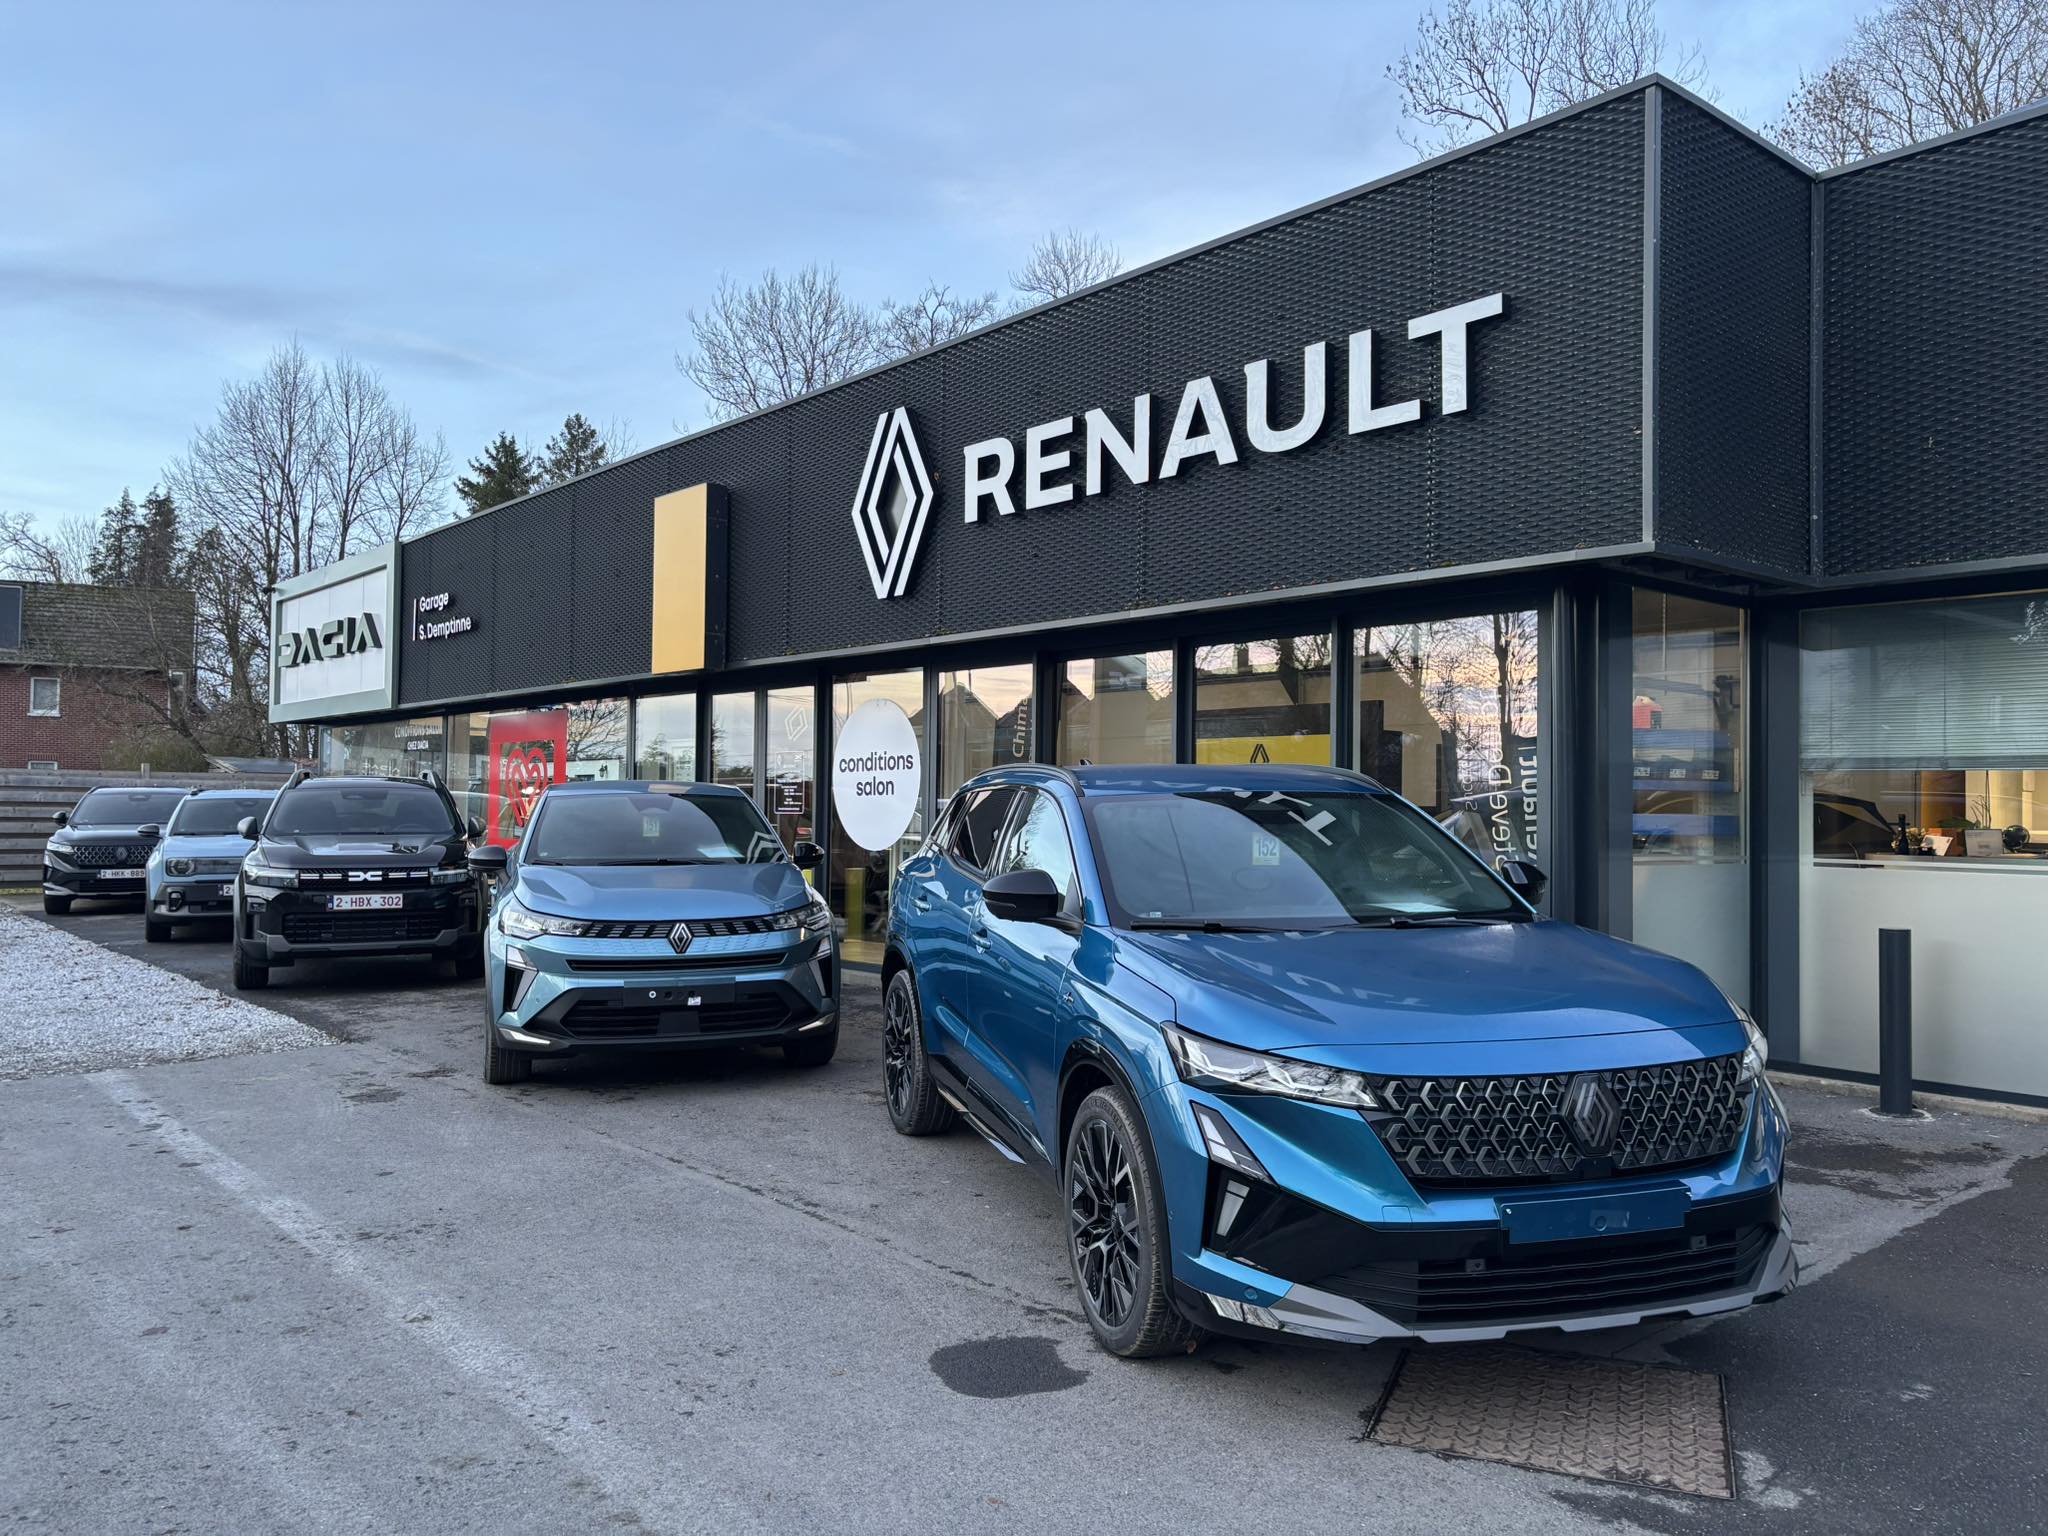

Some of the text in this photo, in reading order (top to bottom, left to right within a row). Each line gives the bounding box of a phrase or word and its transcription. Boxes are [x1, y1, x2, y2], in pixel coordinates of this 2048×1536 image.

[963, 292, 1504, 524] RENAULT
[419, 592, 449, 613] Garage
[419, 615, 472, 640] S. Demptinne
[278, 612, 382, 668] DACIA
[839, 751, 914, 773] conditions
[856, 776, 895, 796] salon
[1256, 839, 1277, 857] 152
